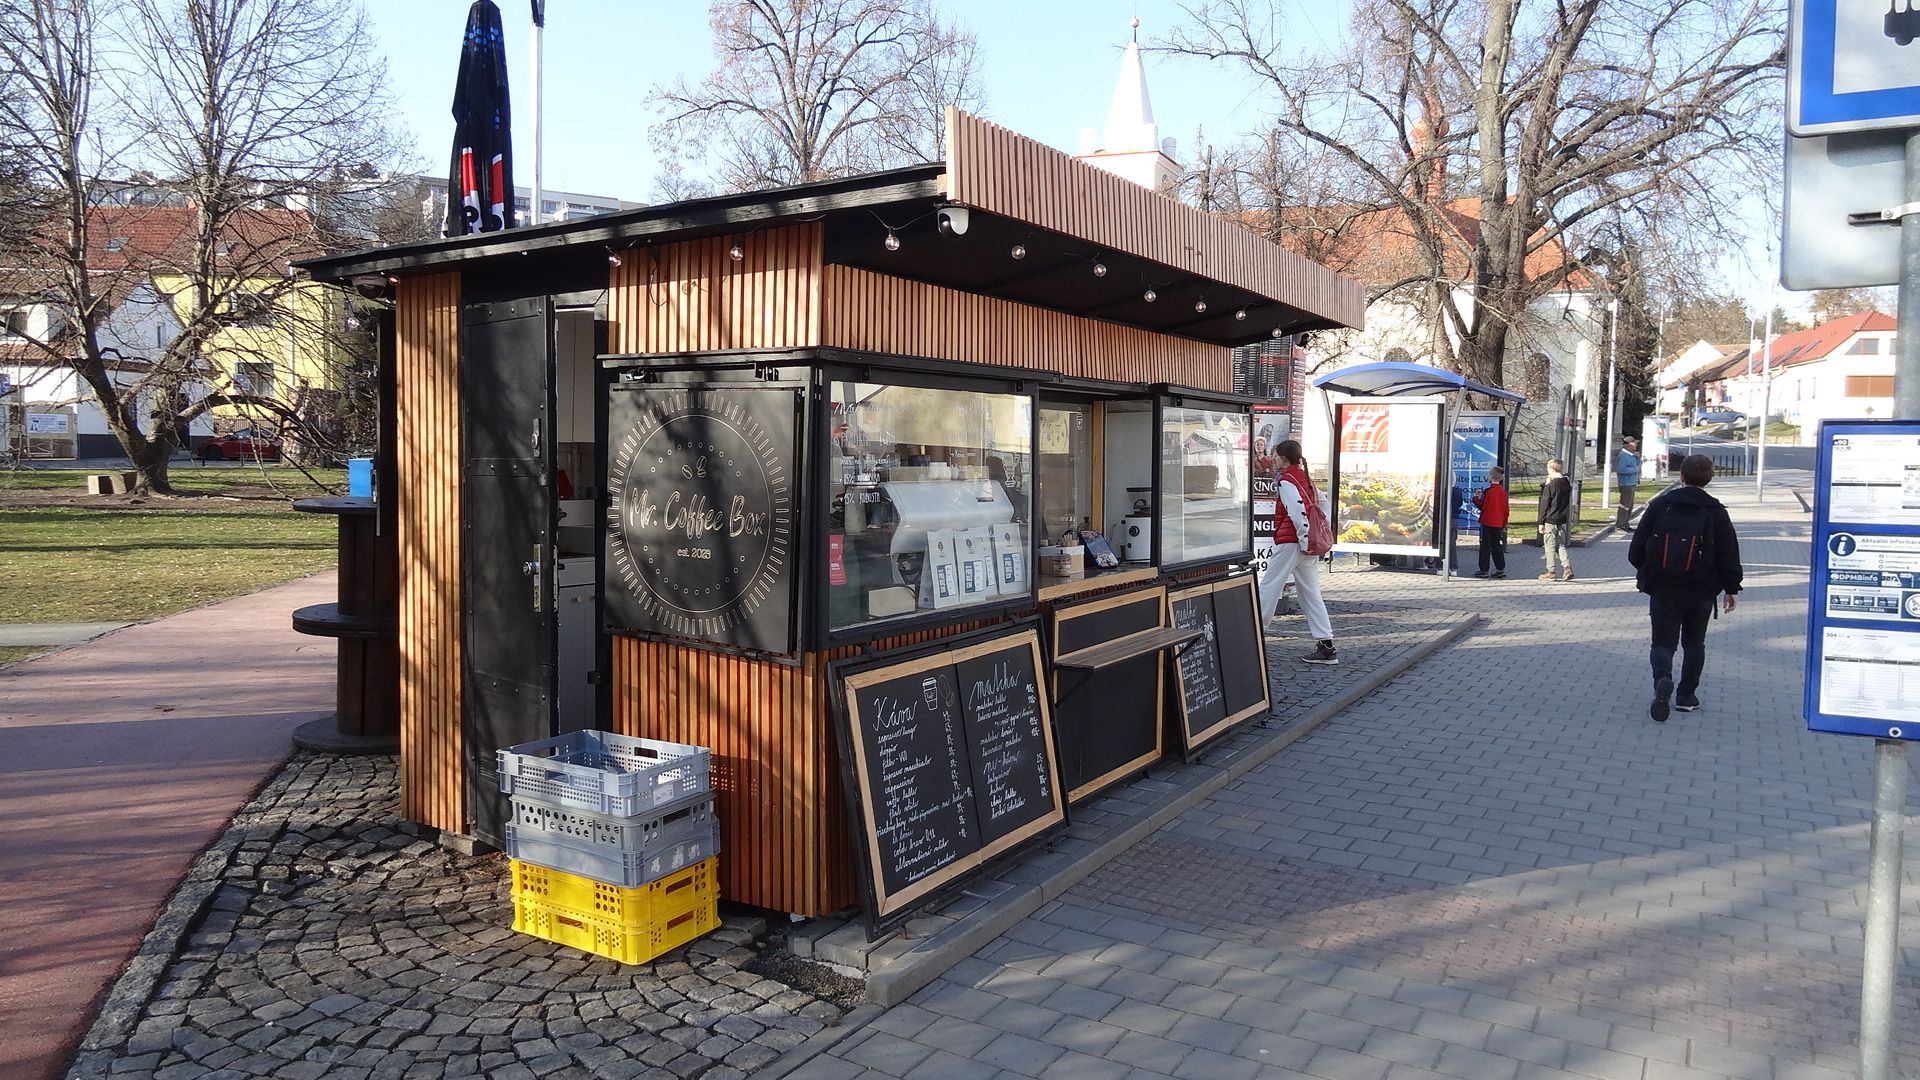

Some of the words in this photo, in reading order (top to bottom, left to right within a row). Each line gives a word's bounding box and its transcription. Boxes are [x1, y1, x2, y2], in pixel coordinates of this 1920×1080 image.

[630, 487, 658, 529] Mr.
[663, 490, 724, 539] Coffee
[729, 494, 766, 538] Box
[873, 696, 918, 731] Káva
[880, 744, 899, 759] doppio
[903, 754, 932, 774] macchiato
